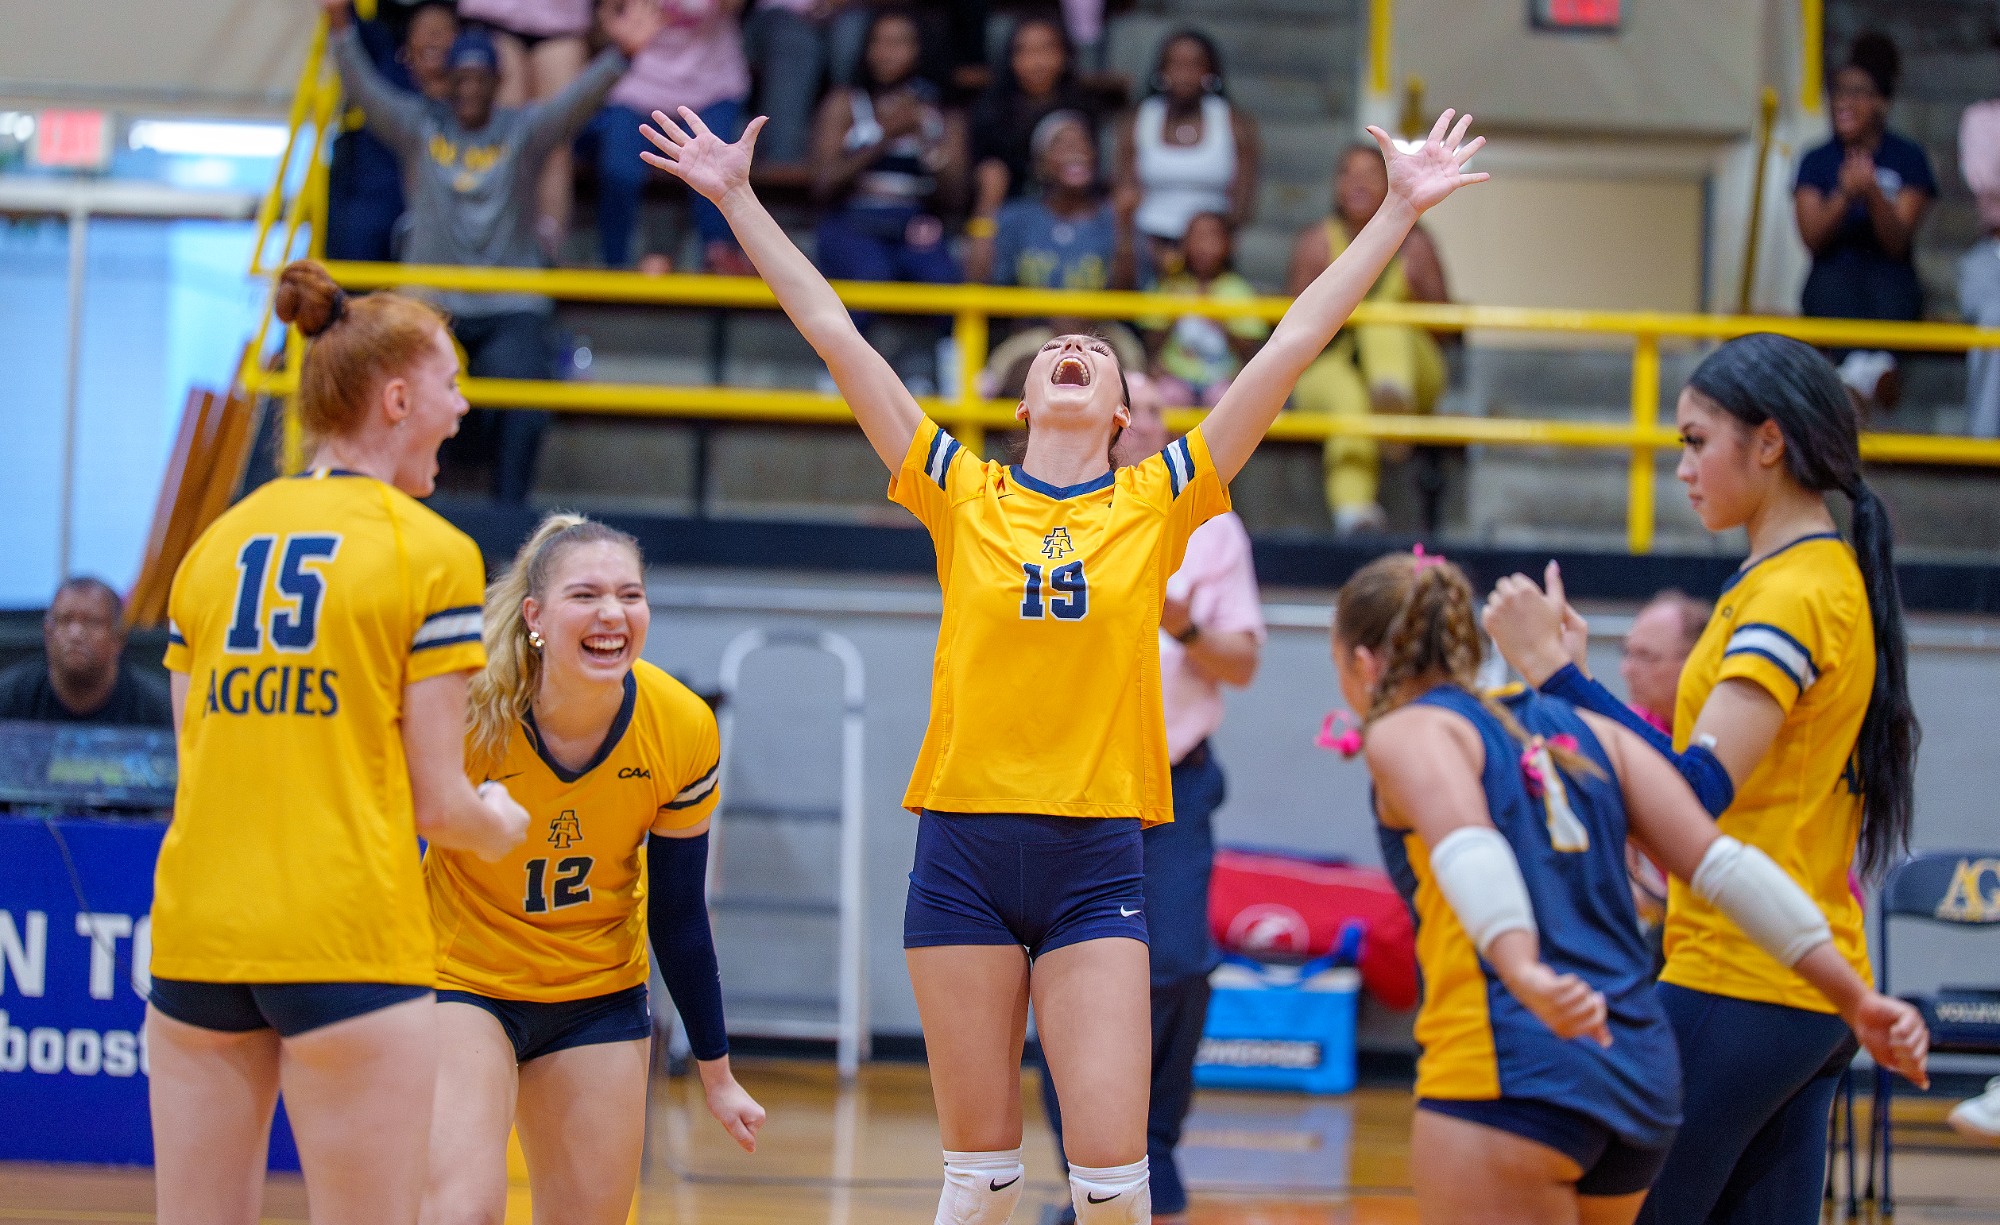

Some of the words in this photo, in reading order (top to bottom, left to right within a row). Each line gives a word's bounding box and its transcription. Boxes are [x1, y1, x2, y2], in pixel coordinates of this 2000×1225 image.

[222, 531, 342, 655] 15
[1019, 558, 1089, 622] 19
[202, 665, 339, 718] AGGIES
[617, 766, 651, 780] CAA
[522, 855, 595, 914] 12
